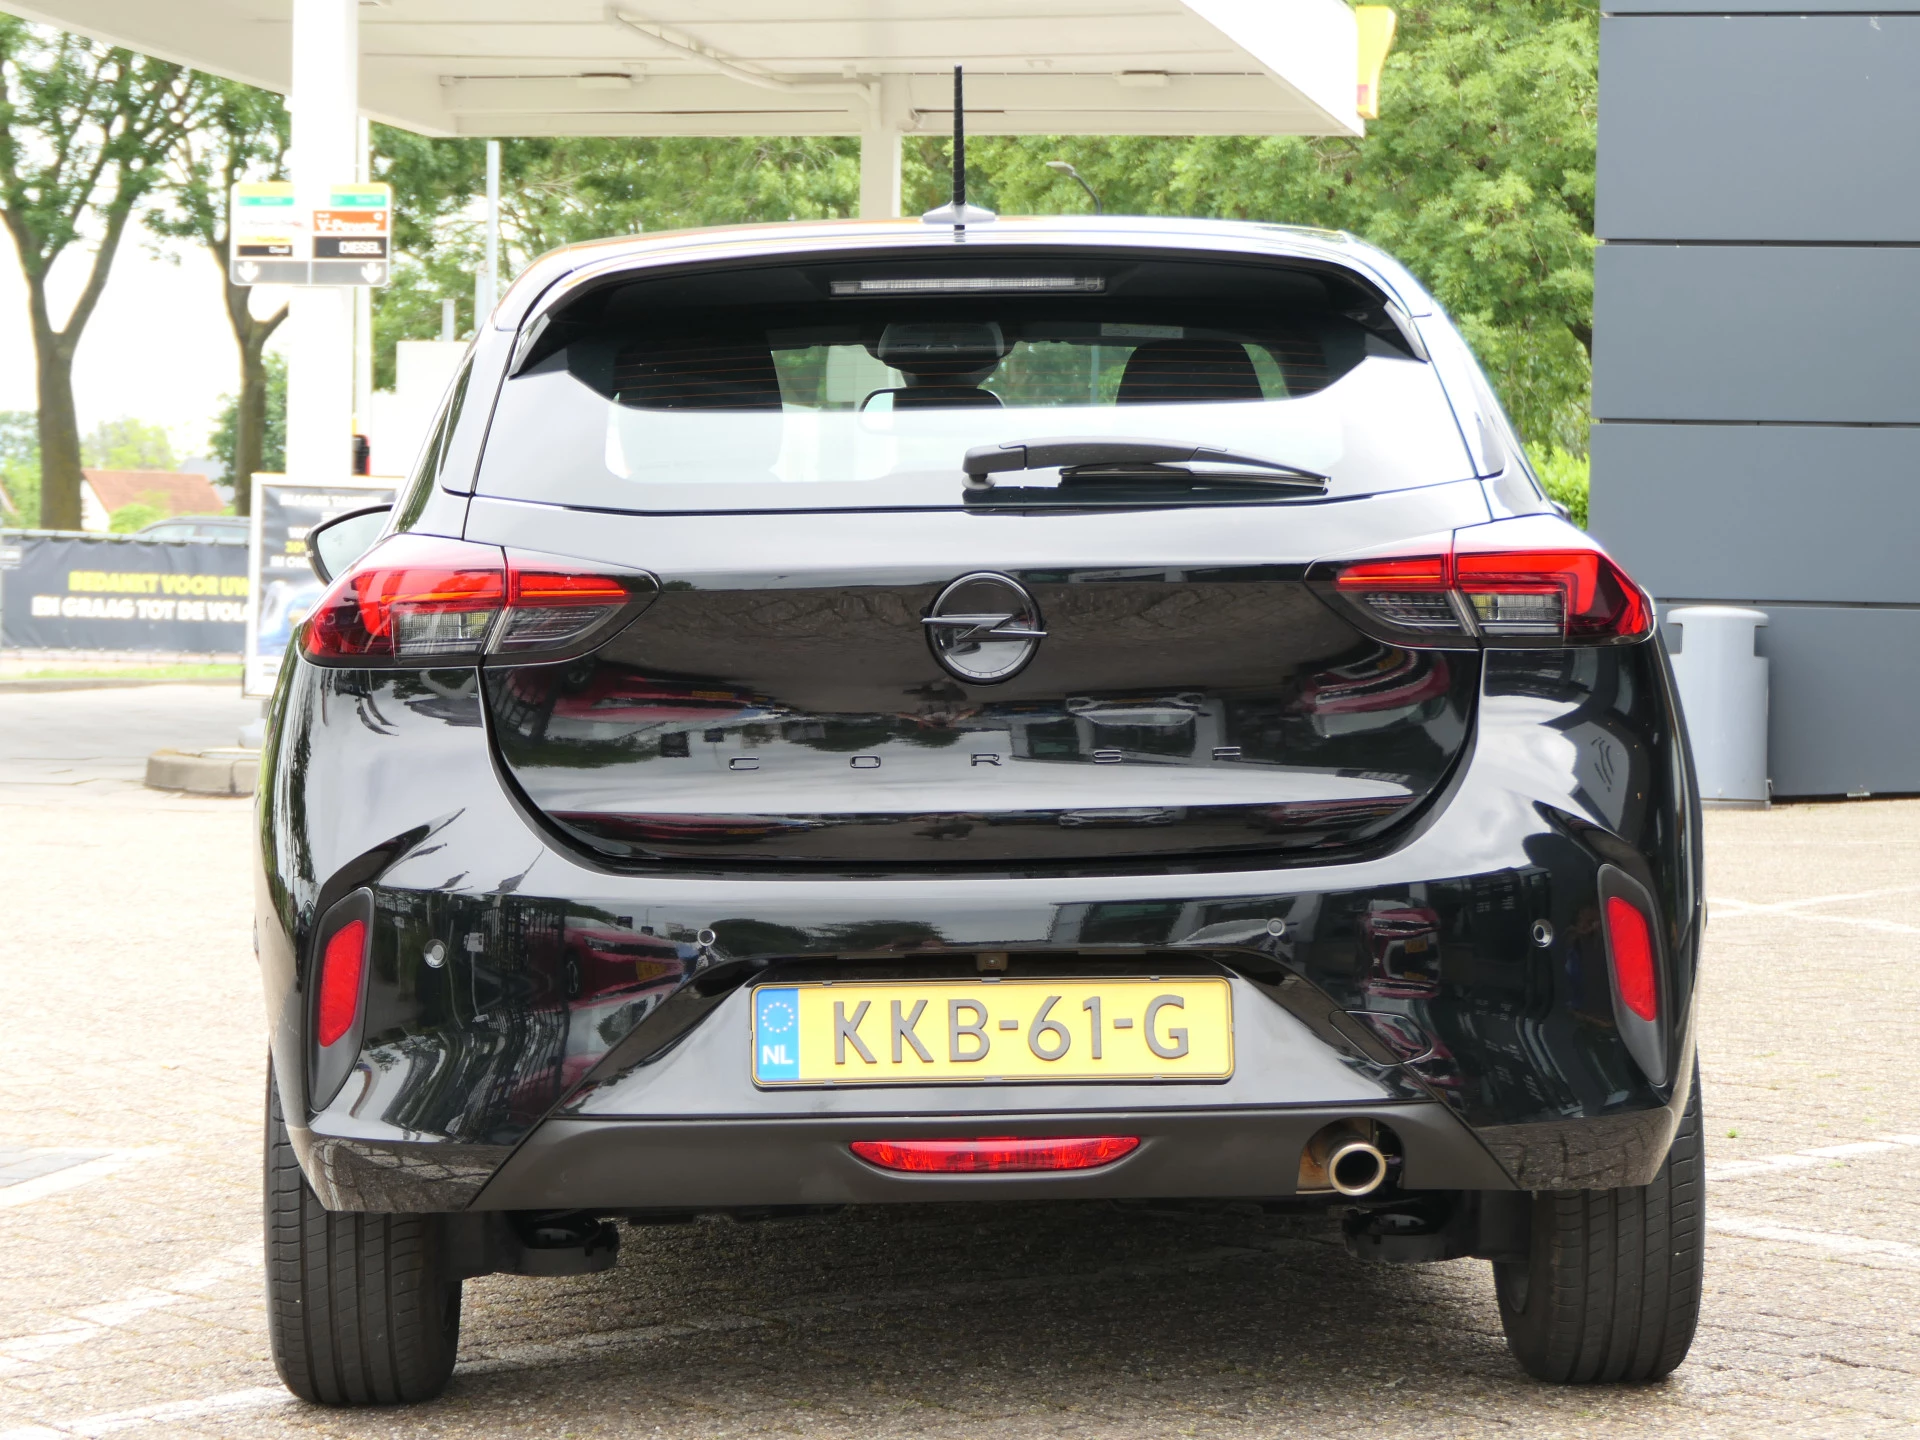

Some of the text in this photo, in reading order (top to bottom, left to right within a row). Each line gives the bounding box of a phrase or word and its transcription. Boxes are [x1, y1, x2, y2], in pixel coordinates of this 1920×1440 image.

[338, 241, 382, 254] DIESEL
[69, 571, 159, 593] BEDANKT
[161, 574, 219, 595] VOOR
[32, 596, 60, 616] EN
[62, 597, 135, 618] GRAAG
[136, 599, 175, 620] TOT
[178, 601, 205, 621] DE
[729, 746, 1241, 771] CORSA
[833, 993, 1190, 1066] KKB-61-G
[761, 1044, 794, 1067] NL
